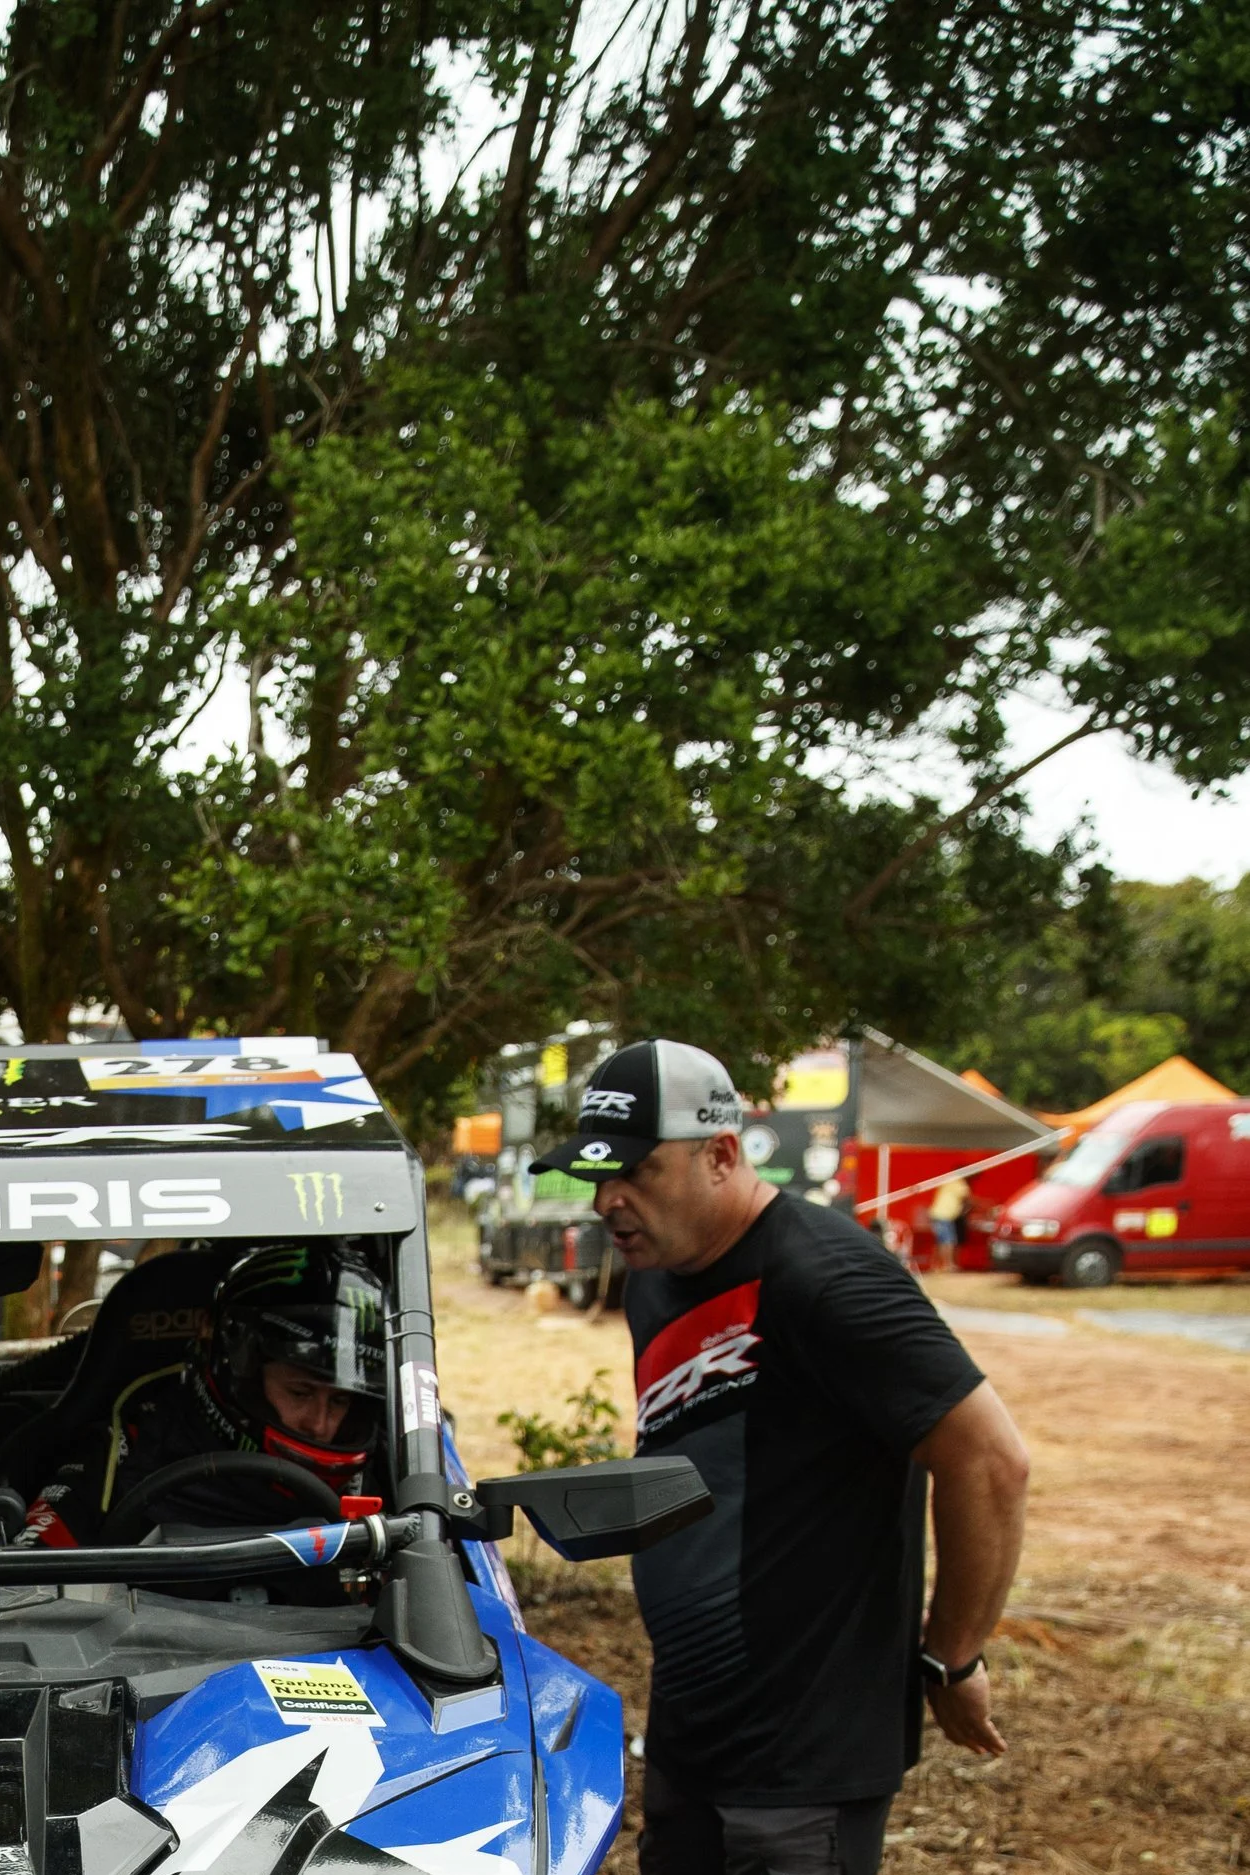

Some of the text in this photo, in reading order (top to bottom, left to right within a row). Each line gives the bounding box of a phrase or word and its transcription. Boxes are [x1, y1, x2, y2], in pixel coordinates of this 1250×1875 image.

[103, 1056, 290, 1076] 278
[270, 1678, 353, 1689] Carbono
[275, 1686, 358, 1698] Neutro
[282, 1700, 368, 1711] Certificado
